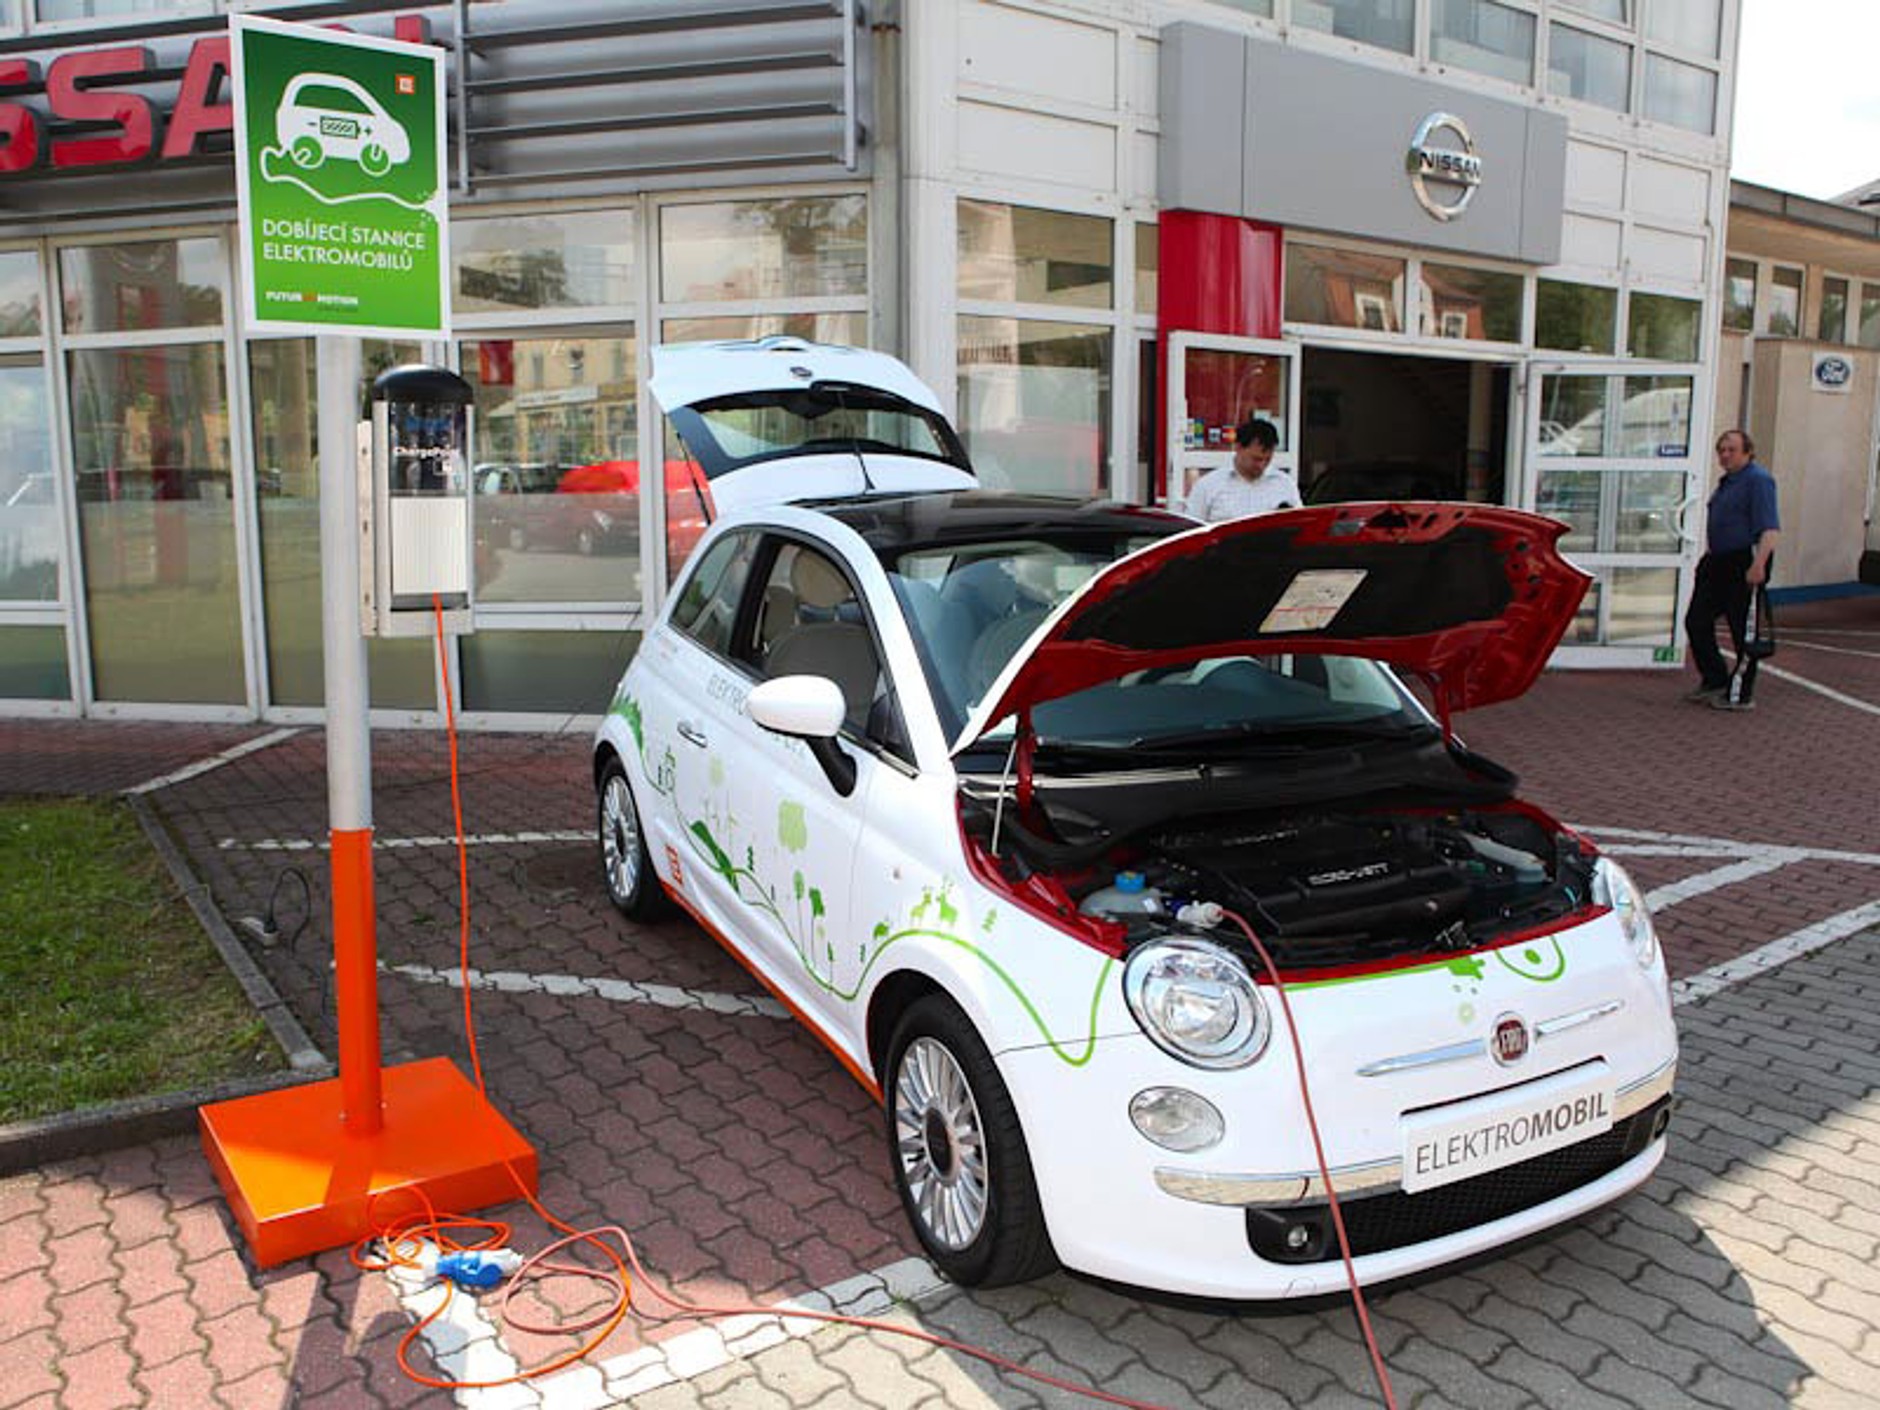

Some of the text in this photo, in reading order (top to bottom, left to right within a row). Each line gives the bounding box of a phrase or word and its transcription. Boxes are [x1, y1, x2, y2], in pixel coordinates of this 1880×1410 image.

[1420, 151, 1480, 178] NISSAN
[263, 218, 426, 250] DOBÍJECÍ STANICE
[263, 242, 413, 271] ELEKTROMOBILŮ
[1416, 1092, 1609, 1175] ELEKTROMOBIL
